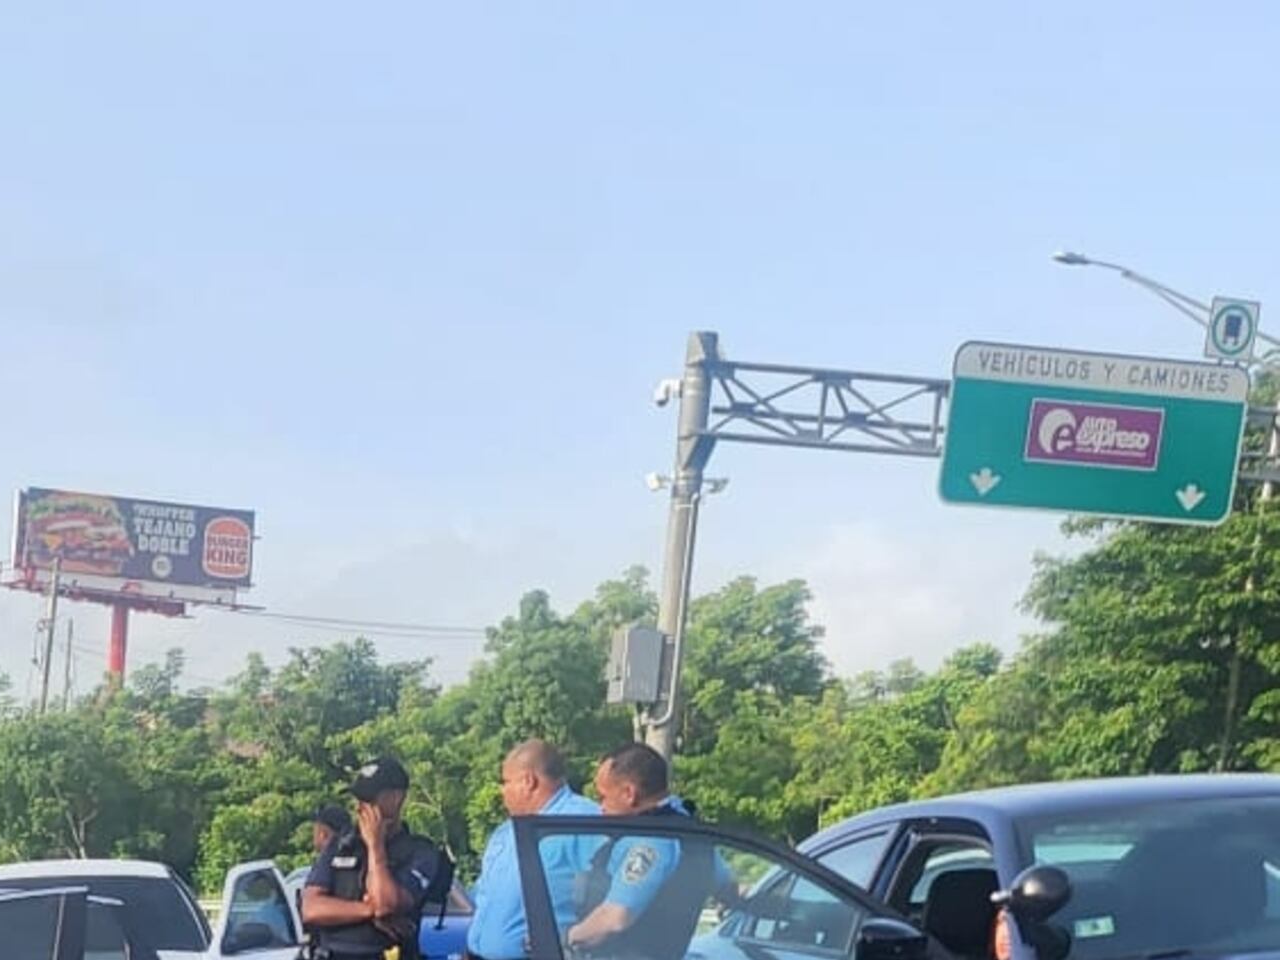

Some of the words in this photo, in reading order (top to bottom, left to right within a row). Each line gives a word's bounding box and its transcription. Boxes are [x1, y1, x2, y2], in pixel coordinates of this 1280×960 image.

[1104, 363, 1117, 381] Y
[1127, 365, 1230, 393] CAMIONES
[133, 517, 197, 539] TEJANO
[138, 534, 190, 555] DOBLE
[206, 547, 247, 565] KING
